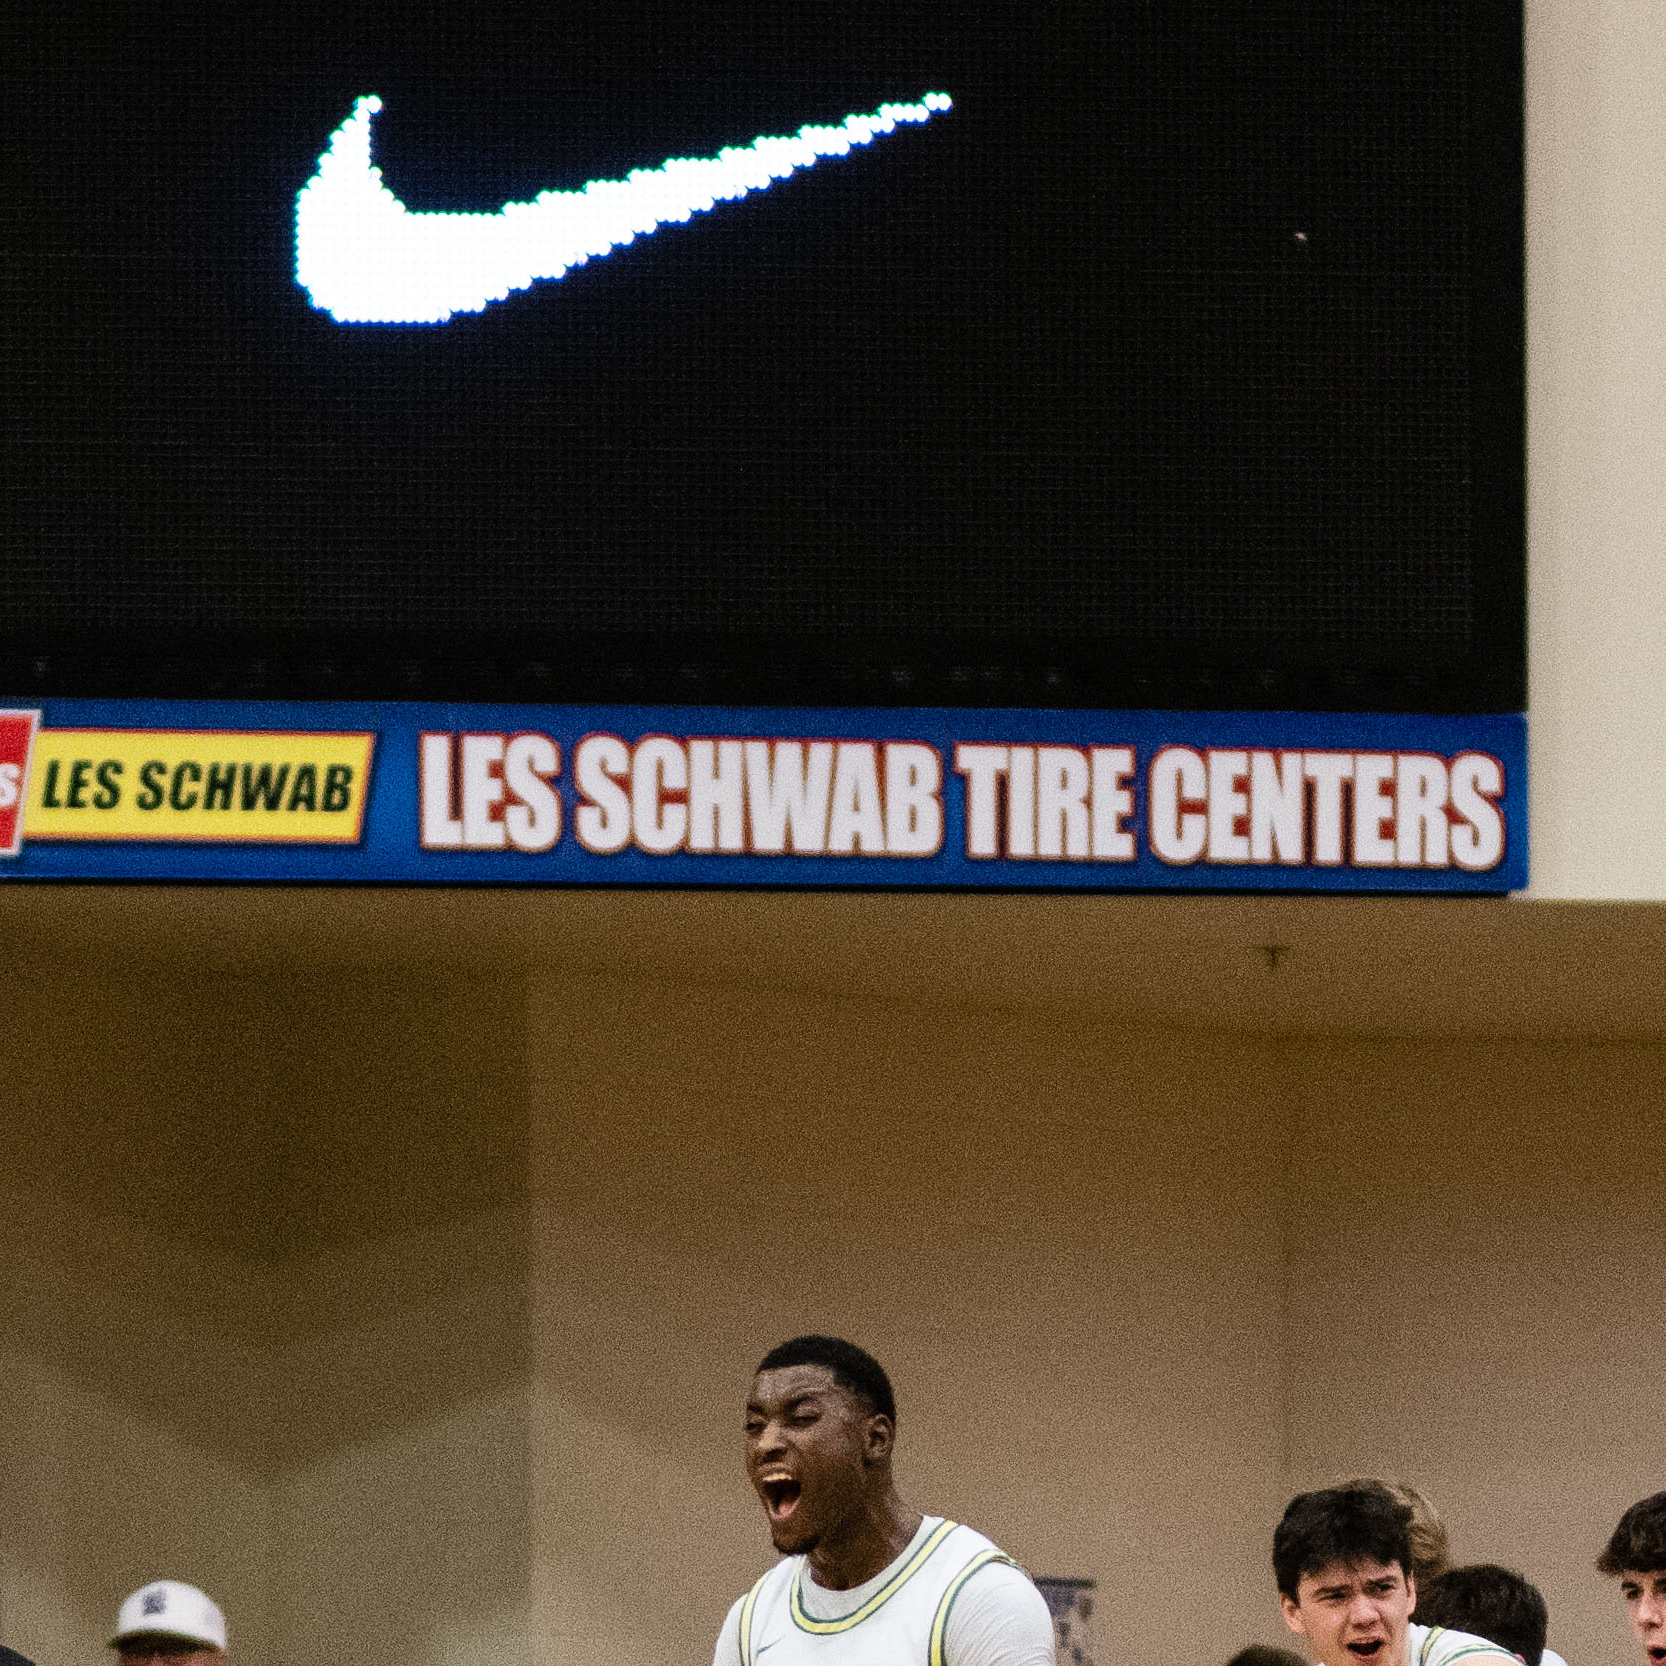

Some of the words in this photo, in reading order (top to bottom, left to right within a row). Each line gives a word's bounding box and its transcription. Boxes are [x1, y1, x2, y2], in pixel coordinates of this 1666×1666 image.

[40, 758, 124, 810] LES
[136, 760, 355, 813] SCHWAB
[419, 731, 563, 852] LES
[573, 733, 945, 858] SCHWAB
[954, 741, 1135, 861] TIRE
[1148, 744, 1506, 871] CENTERS
